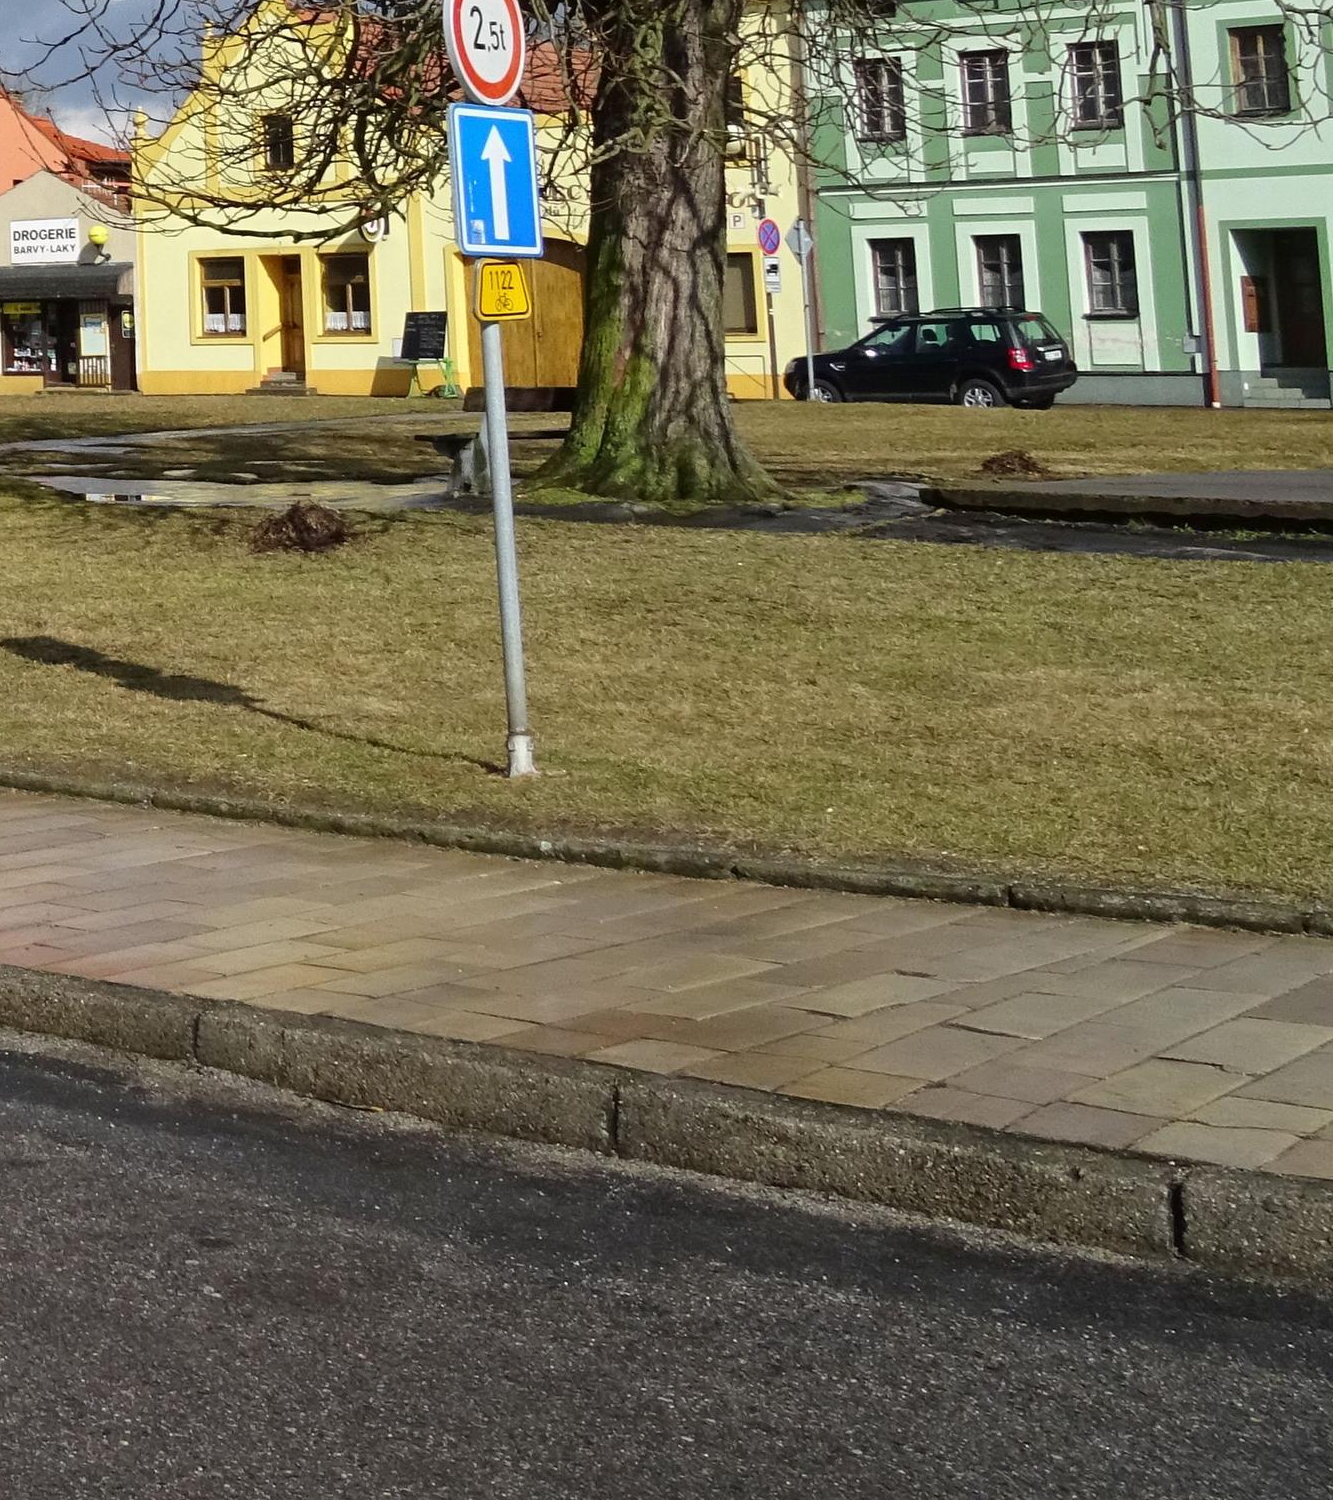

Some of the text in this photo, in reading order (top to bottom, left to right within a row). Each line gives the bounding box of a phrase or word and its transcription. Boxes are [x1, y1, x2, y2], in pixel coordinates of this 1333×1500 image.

[732, 215, 742, 226] P
[13, 228, 76, 241] DROGERIE
[489, 270, 514, 289] 1122
